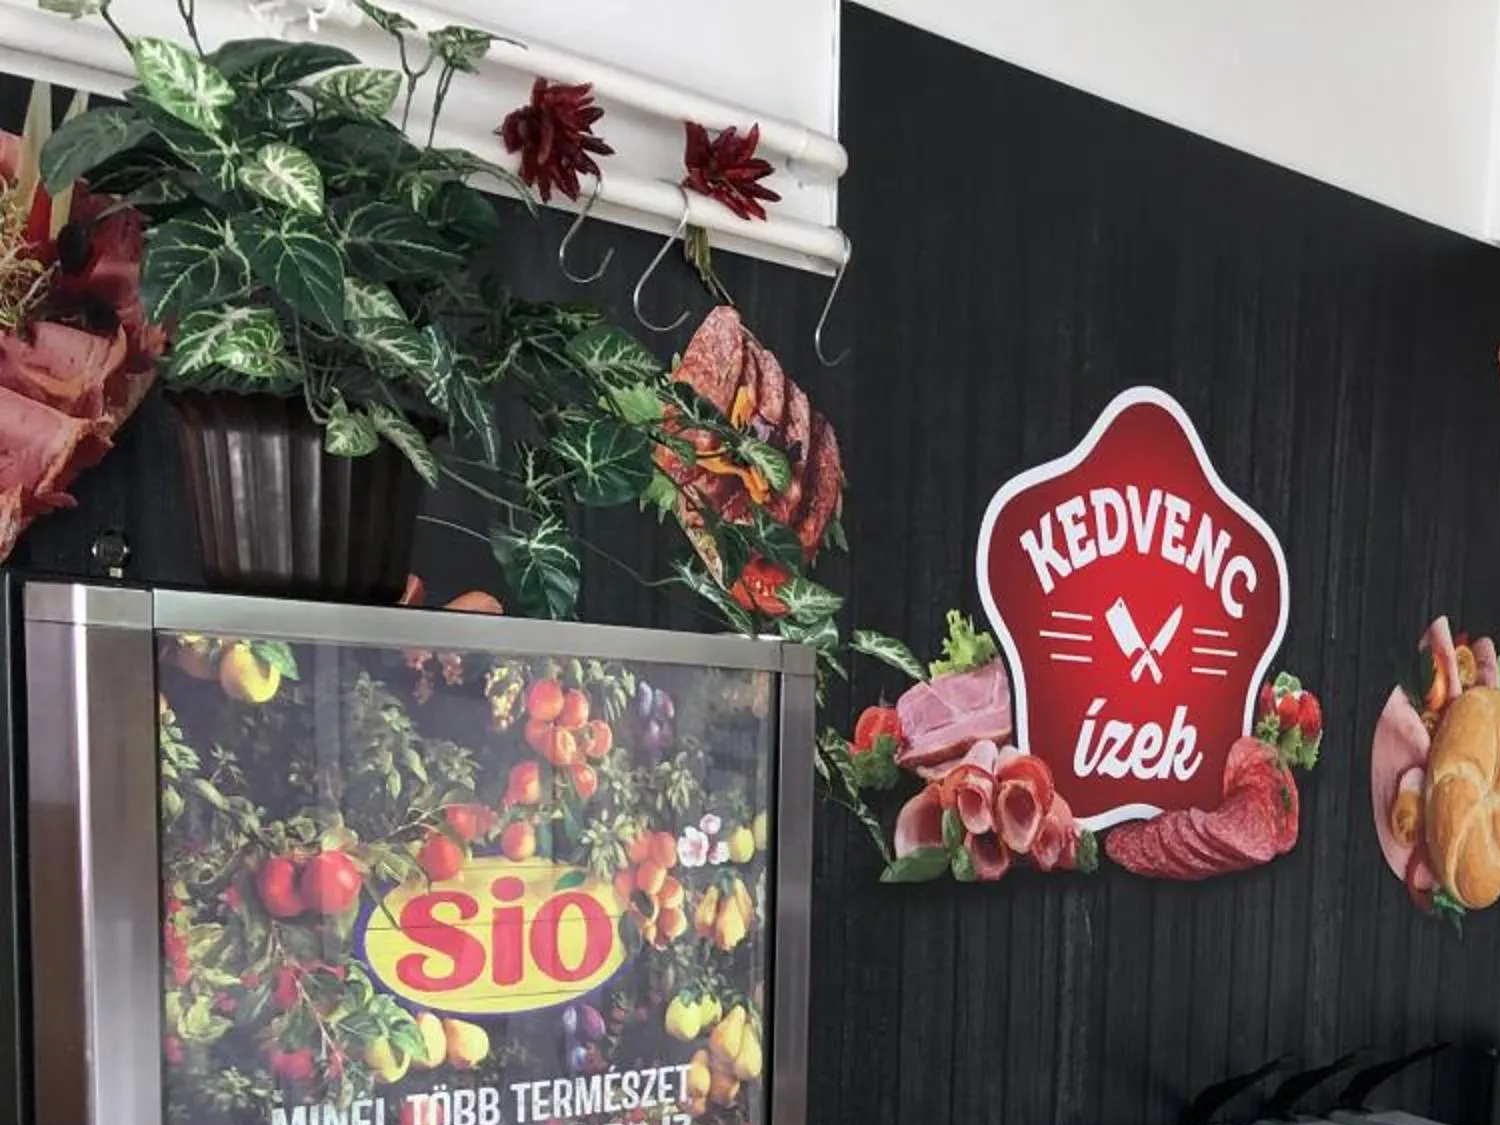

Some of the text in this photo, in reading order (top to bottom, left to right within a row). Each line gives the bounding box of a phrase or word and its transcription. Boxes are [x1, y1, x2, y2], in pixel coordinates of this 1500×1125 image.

[1020, 485, 1257, 619] KEDVENC
[1072, 697, 1204, 781] ízek
[510, 1063, 693, 1124] TERMÉSZET
